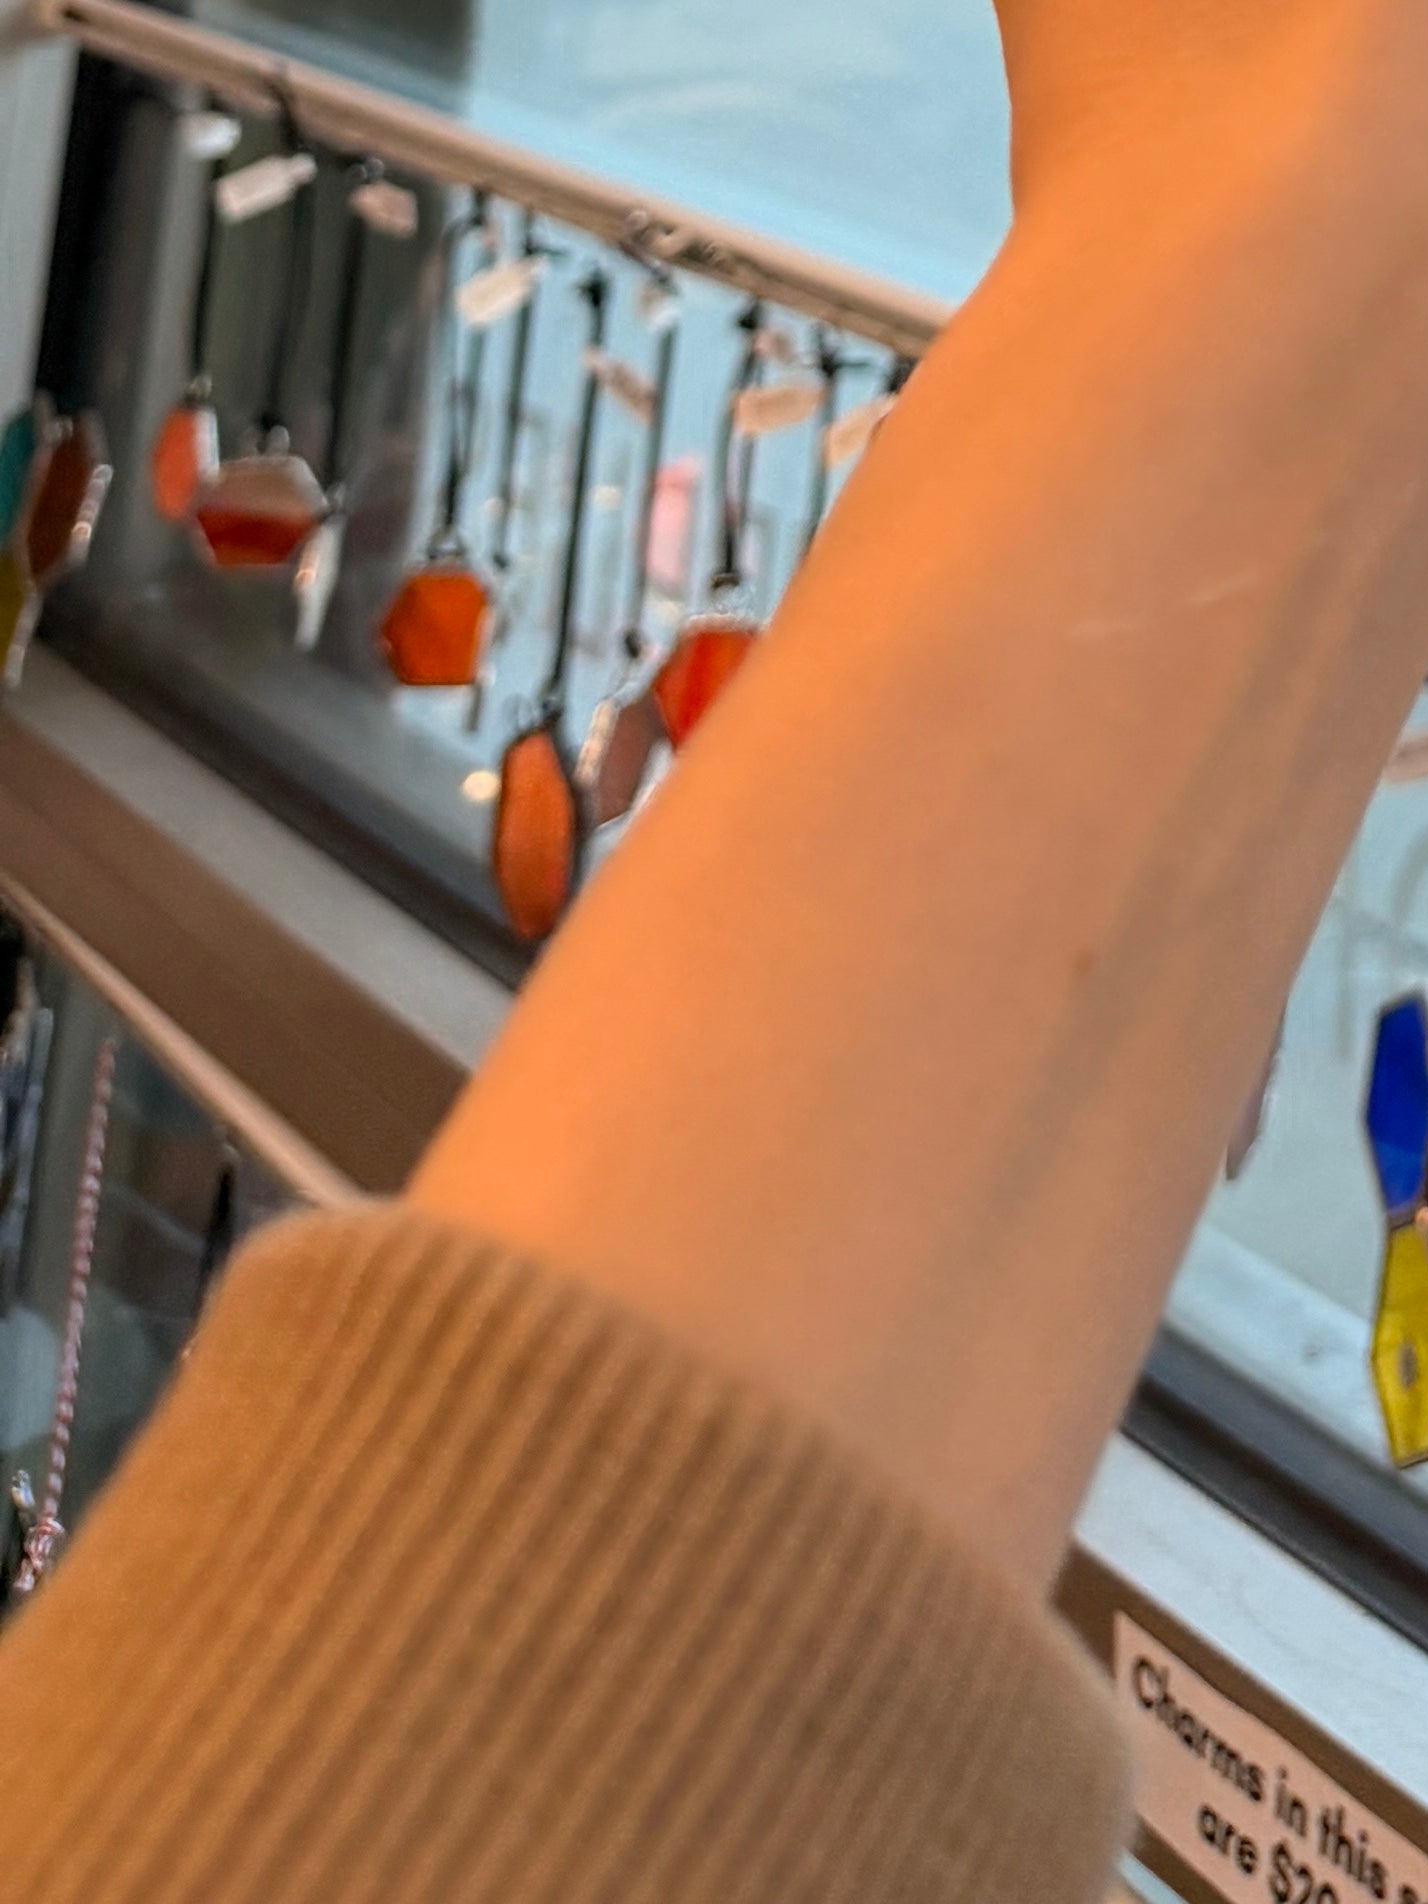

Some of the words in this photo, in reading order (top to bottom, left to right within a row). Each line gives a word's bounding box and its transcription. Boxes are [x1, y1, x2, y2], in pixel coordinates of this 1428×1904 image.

[1132, 1655, 1266, 1803] Charms
[1274, 1765, 1309, 1838] in
[1317, 1804, 1388, 1901] this
[1199, 1802, 1259, 1875] are
